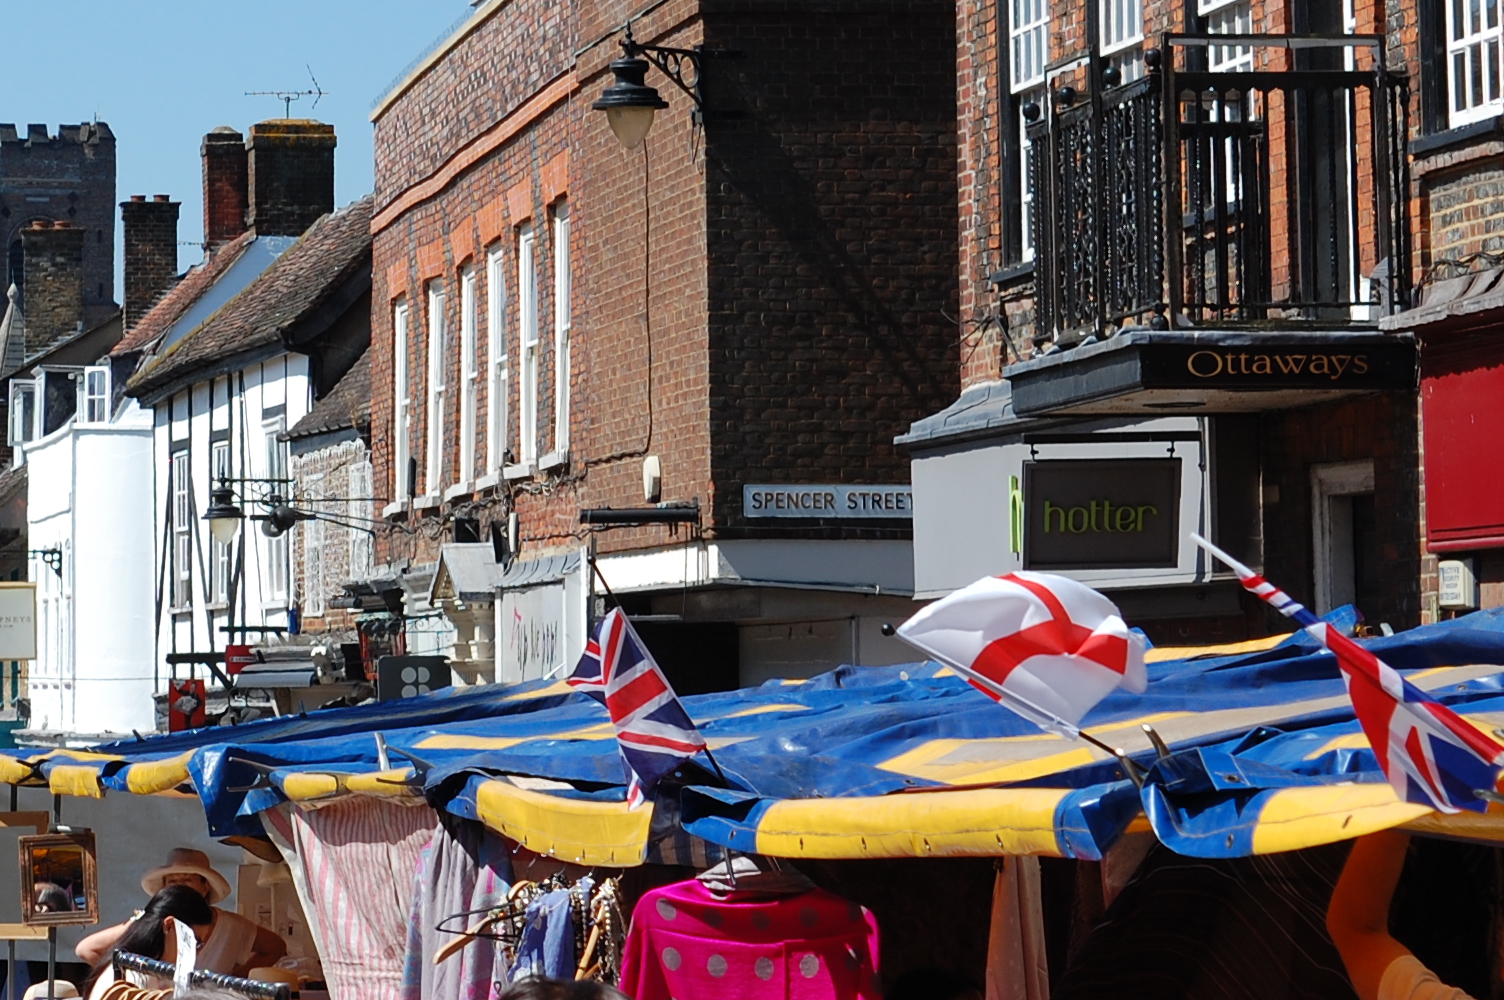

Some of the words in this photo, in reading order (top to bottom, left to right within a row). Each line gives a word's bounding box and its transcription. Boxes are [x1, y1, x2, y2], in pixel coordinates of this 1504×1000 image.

[1187, 350, 1369, 380] Ottaways
[752, 491, 835, 510] SPENCER
[1044, 499, 1158, 534] hotter
